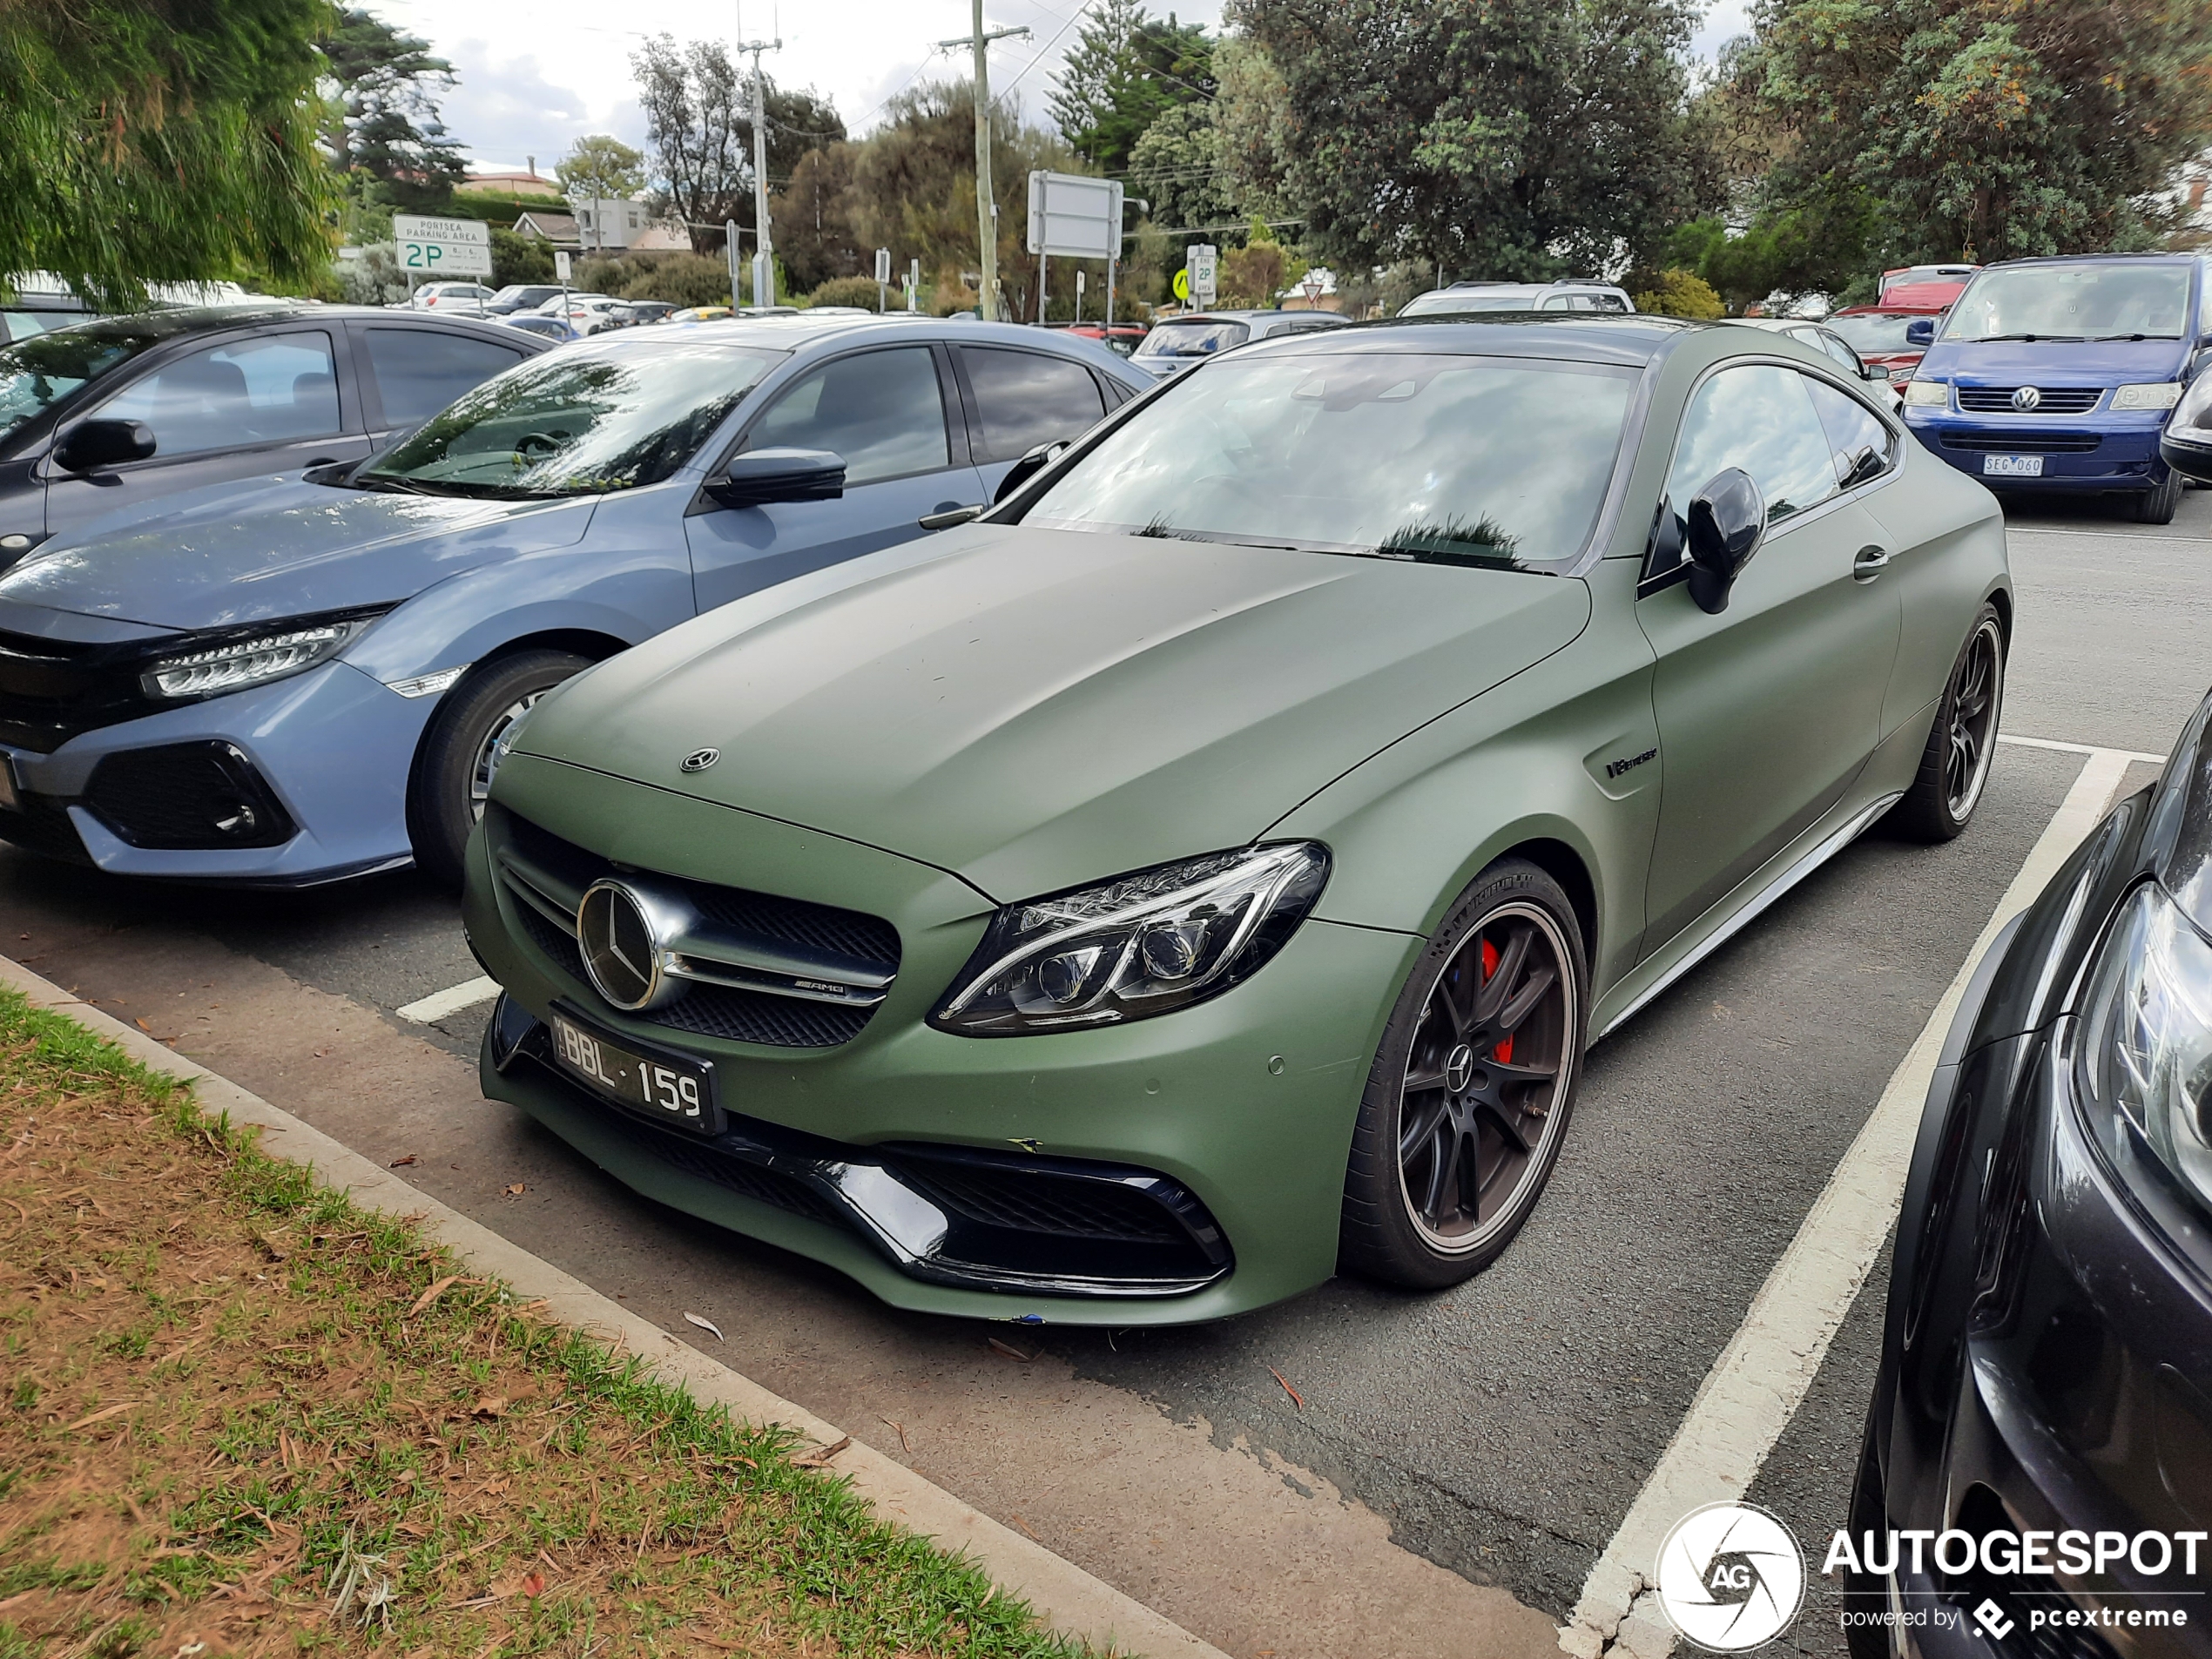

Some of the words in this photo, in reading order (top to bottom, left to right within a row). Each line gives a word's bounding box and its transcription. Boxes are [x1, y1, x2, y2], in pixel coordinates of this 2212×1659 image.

[421, 220, 462, 232] PORTSEA
[407, 228, 448, 239] PARKING
[453, 233, 477, 241] AREA
[406, 244, 442, 267] 2P
[1198, 267, 1211, 280] 2P
[1986, 458, 2008, 470] SEG
[2017, 459, 2040, 471] 060
[1467, 876, 1514, 910] MICHELIN
[810, 982, 844, 994] AMG
[563, 1022, 616, 1088] BBL
[638, 1062, 700, 1117] 159
